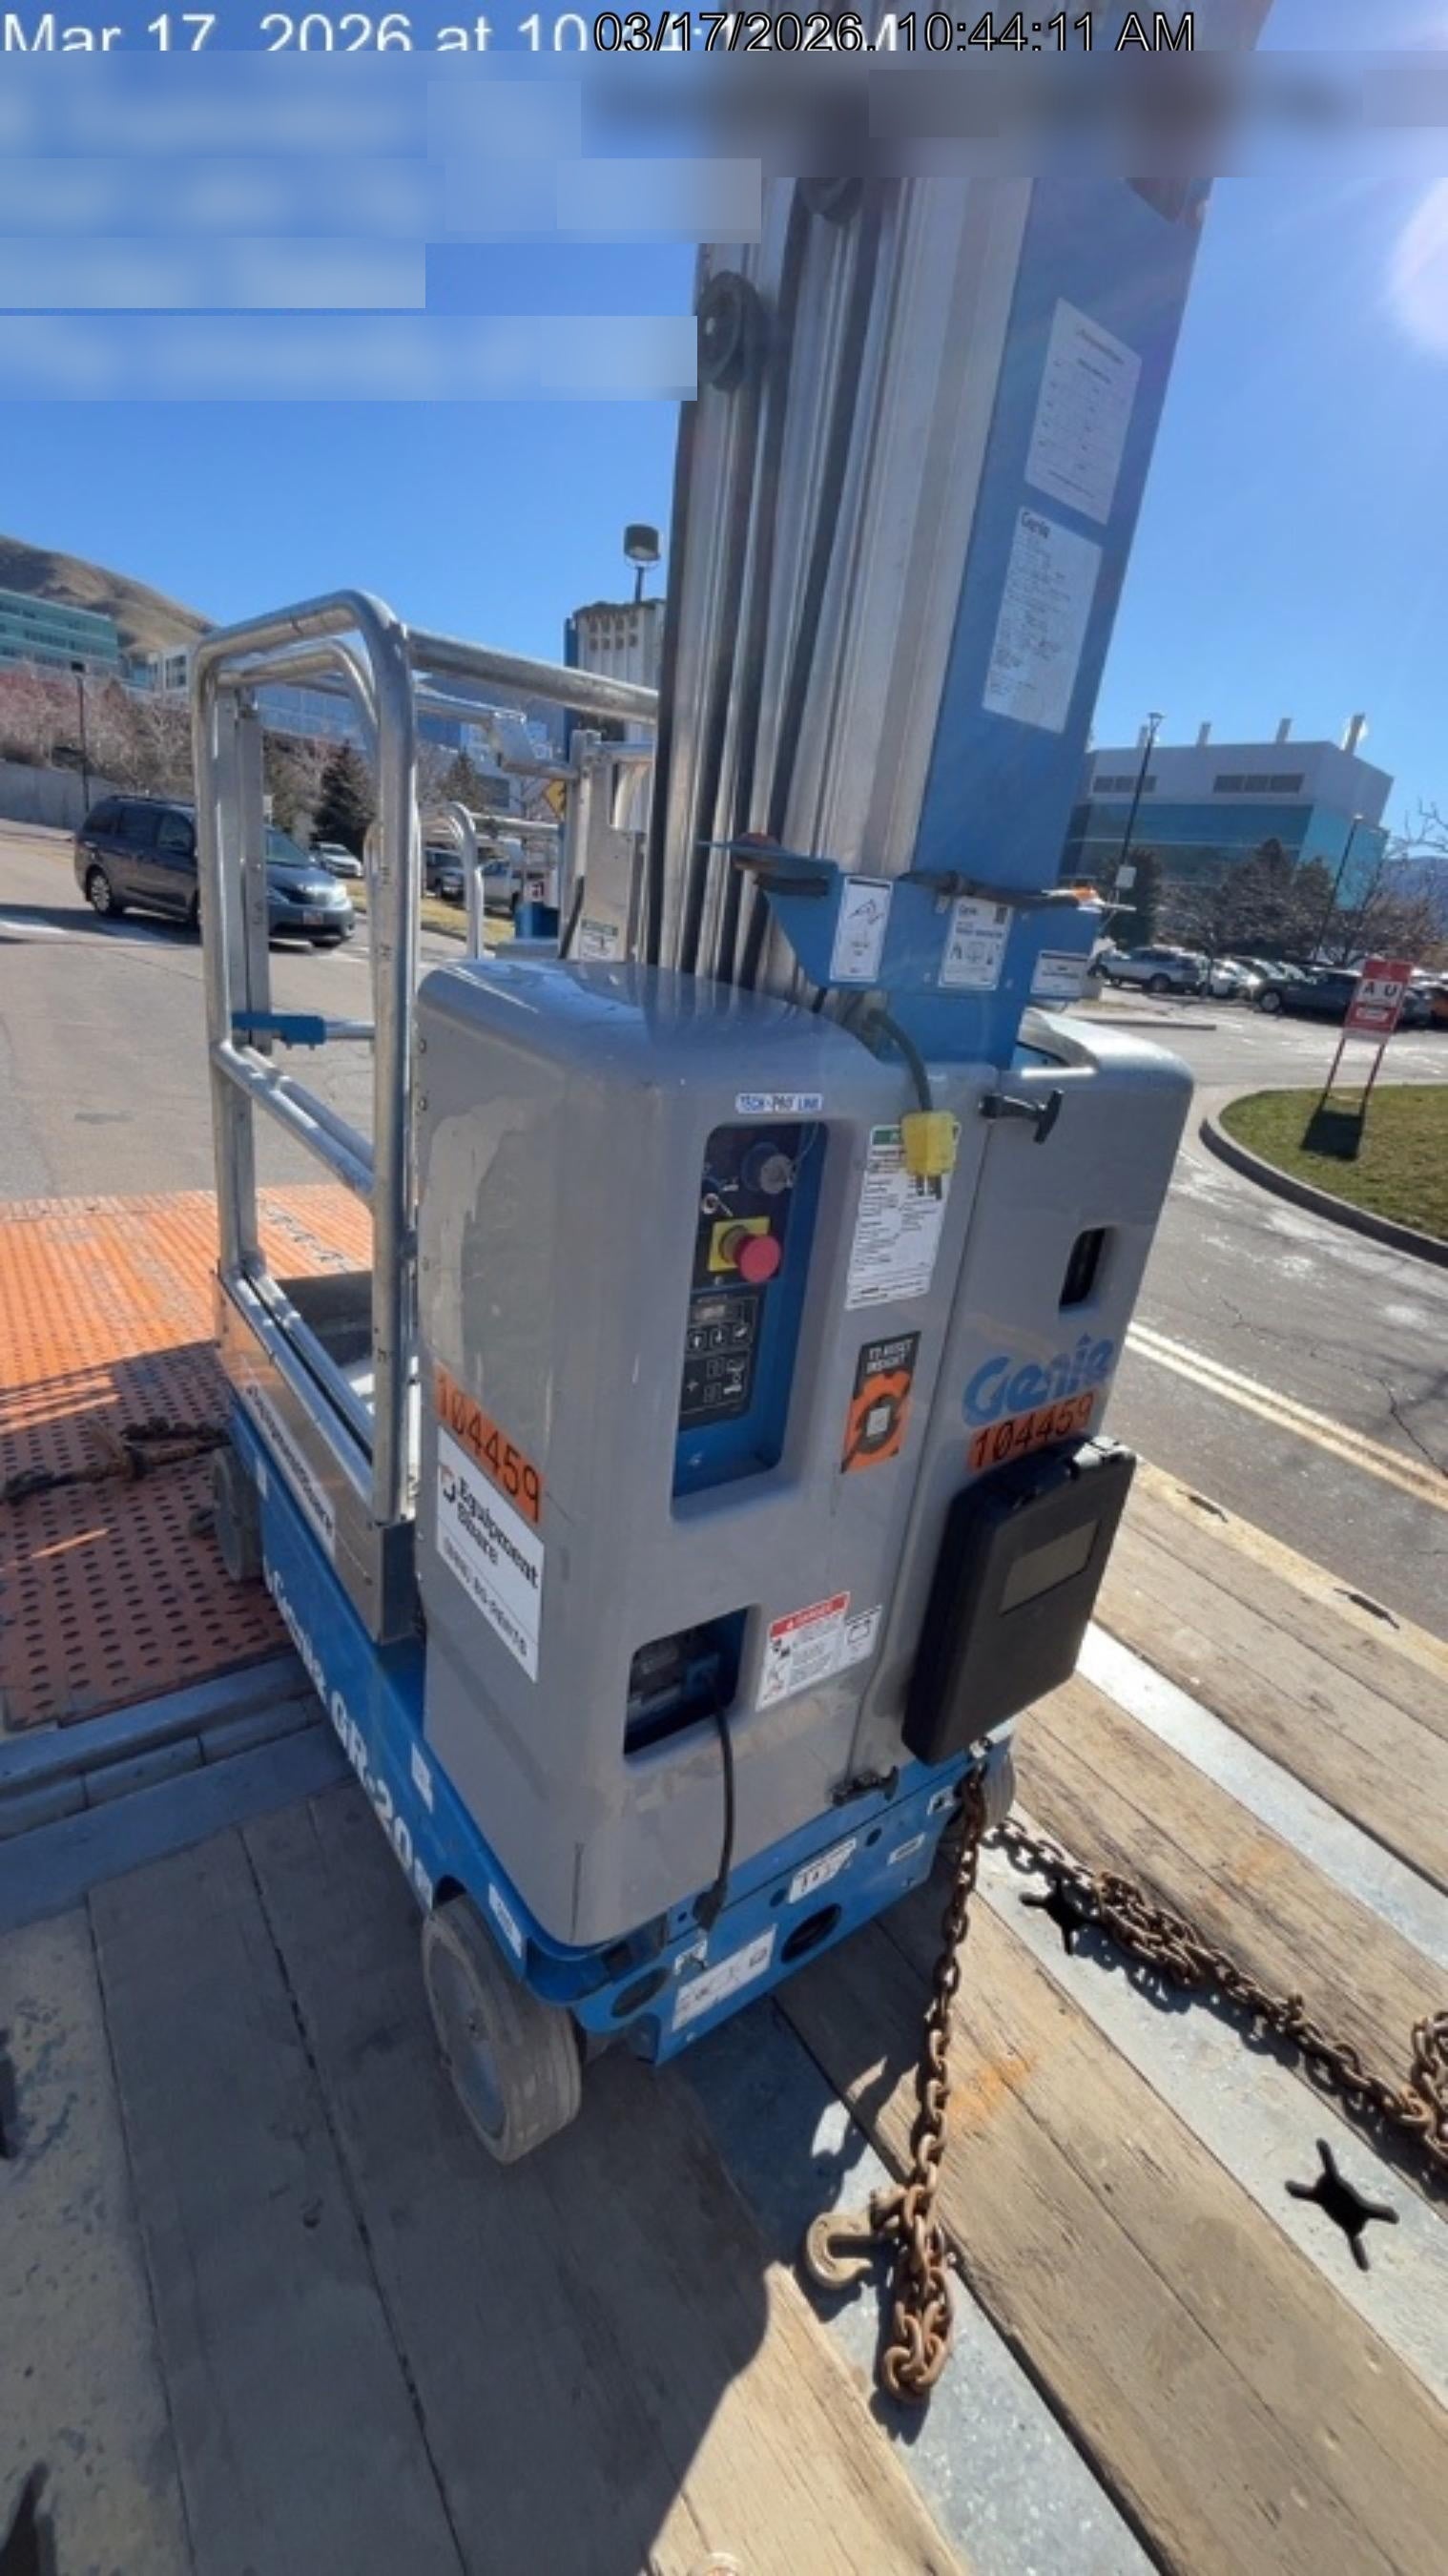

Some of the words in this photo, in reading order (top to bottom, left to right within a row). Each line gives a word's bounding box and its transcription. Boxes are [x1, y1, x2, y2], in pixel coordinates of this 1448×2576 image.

[962, 1333, 1115, 1427] Genie
[975, 1392, 1095, 1468] 104459
[438, 1377, 542, 1523] 104459
[456, 1474, 540, 1590] Equipment
